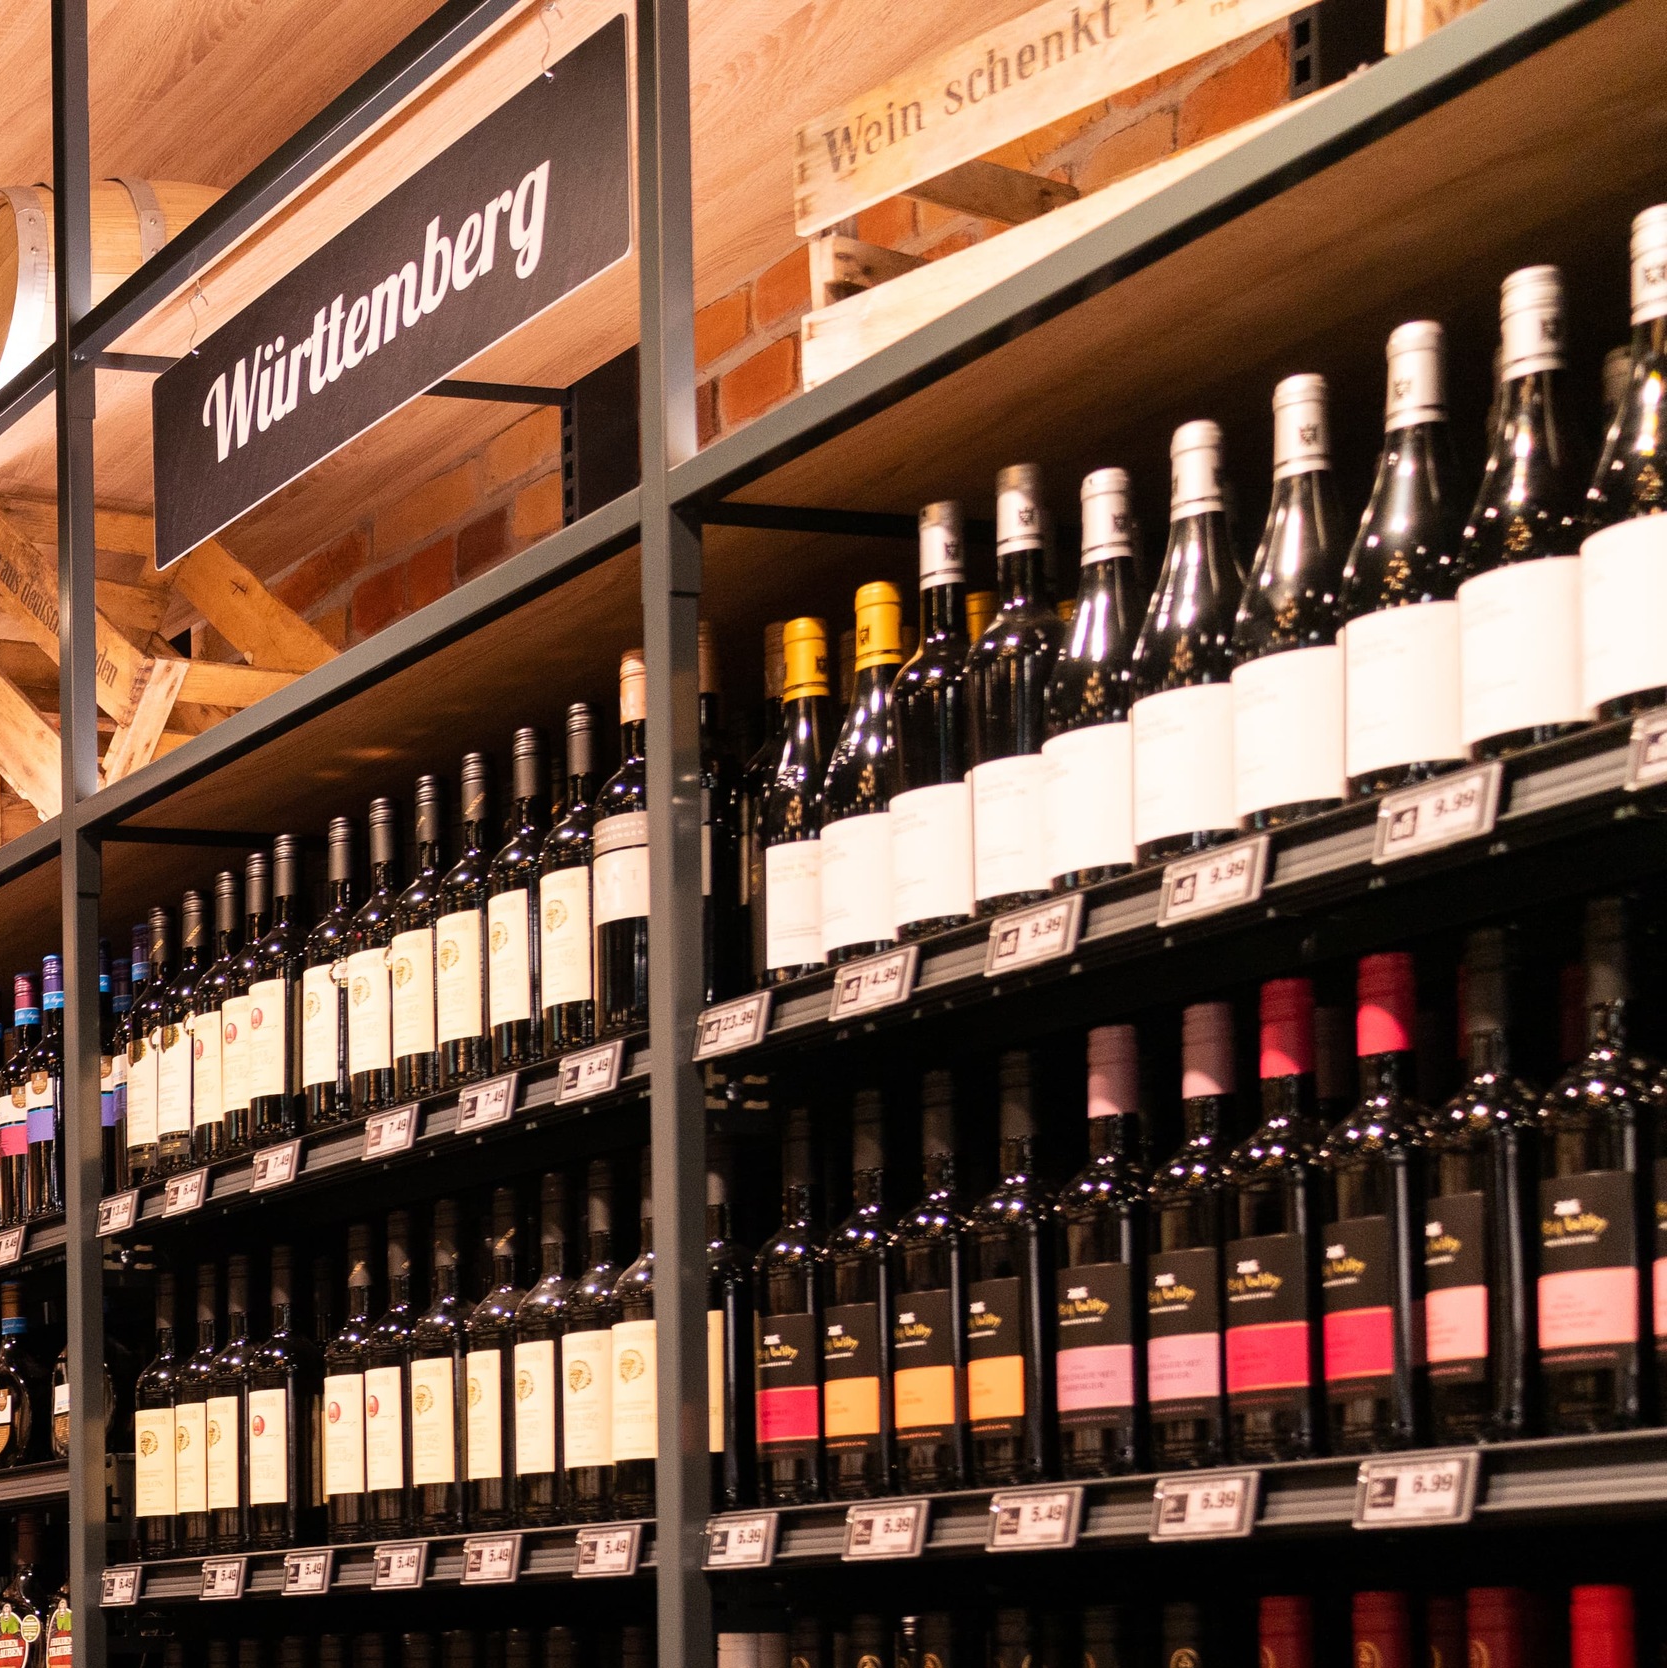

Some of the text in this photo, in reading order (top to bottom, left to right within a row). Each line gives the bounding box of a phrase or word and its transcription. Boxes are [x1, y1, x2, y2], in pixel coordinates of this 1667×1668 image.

[822, 2, 1119, 176] Wein schenkt
[203, 158, 551, 464] Württemberg
[1030, 916, 1062, 939] 9.99
[861, 964, 899, 989] 14.99
[1412, 1473, 1454, 1494] 6.99
[1201, 1490, 1237, 1510] 6.99
[882, 1517, 911, 1534] 6.99
